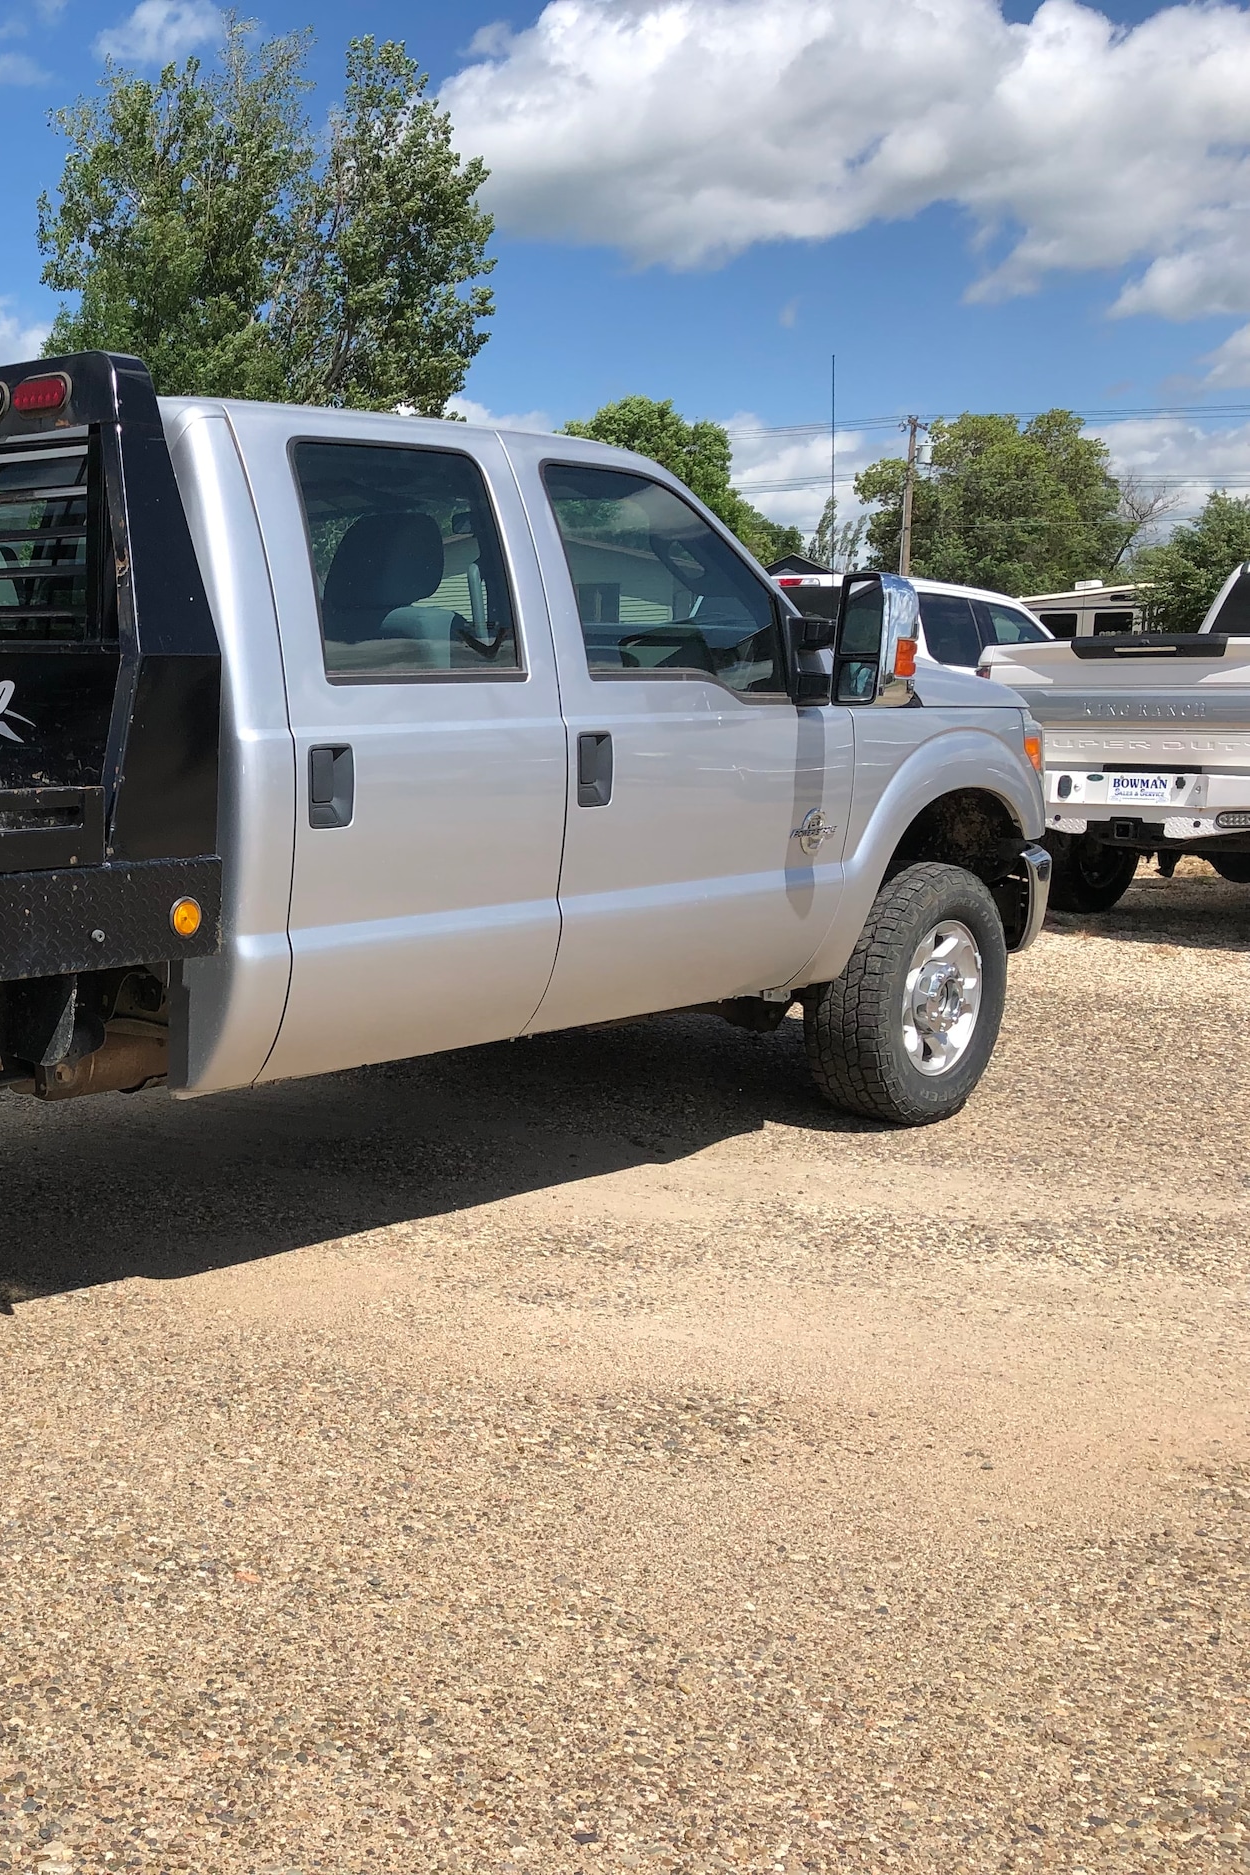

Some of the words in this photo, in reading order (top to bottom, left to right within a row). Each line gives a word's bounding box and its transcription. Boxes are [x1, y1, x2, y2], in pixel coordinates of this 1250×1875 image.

[1082, 702, 1129, 716] KING
[1137, 702, 1206, 717] RANCH
[1044, 738, 1151, 750] UPER
[1112, 778, 1168, 789] BOWMAN
